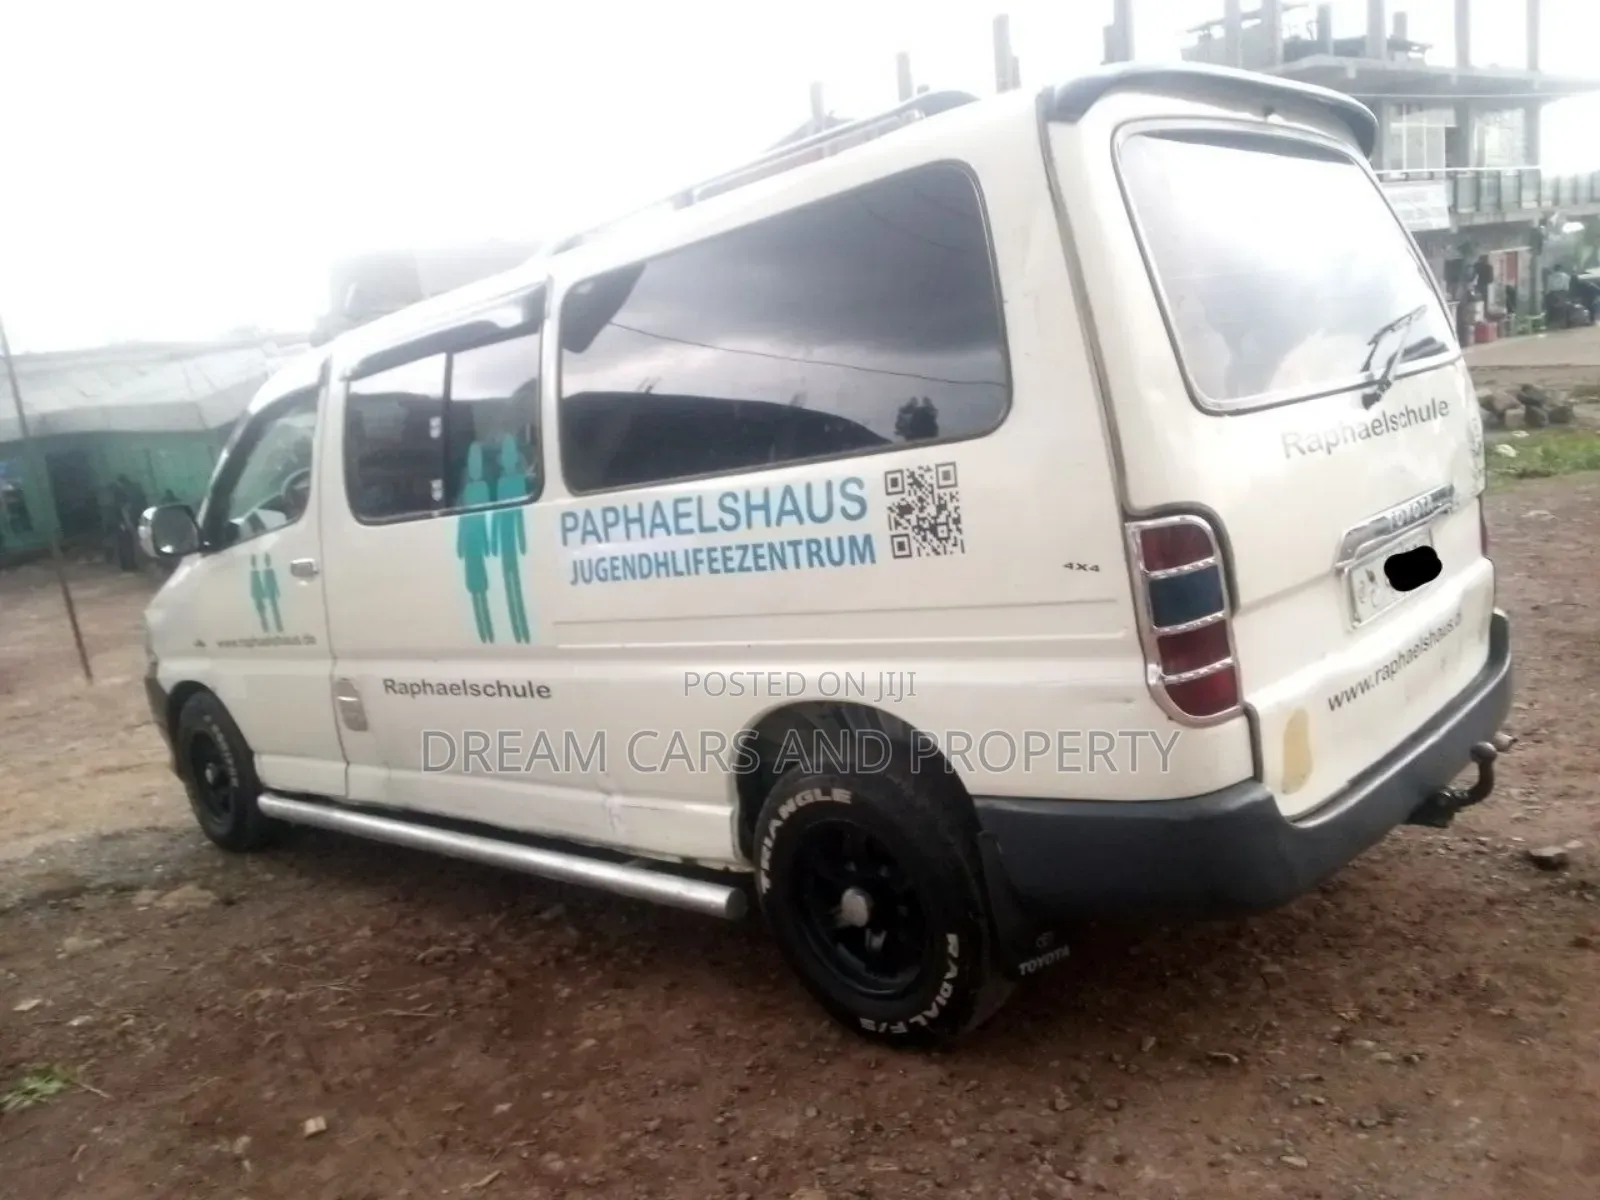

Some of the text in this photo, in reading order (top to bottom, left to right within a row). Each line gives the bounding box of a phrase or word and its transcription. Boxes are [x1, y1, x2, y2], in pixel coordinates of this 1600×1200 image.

[1281, 398, 1450, 459] Raphaelschule
[560, 476, 869, 547] PAPHAELSHAUS
[569, 533, 877, 586] JUGENDHLIFEEZENTRUM
[382, 678, 552, 700] Raphaelschule
[1018, 945, 1070, 977] TOYOTA
